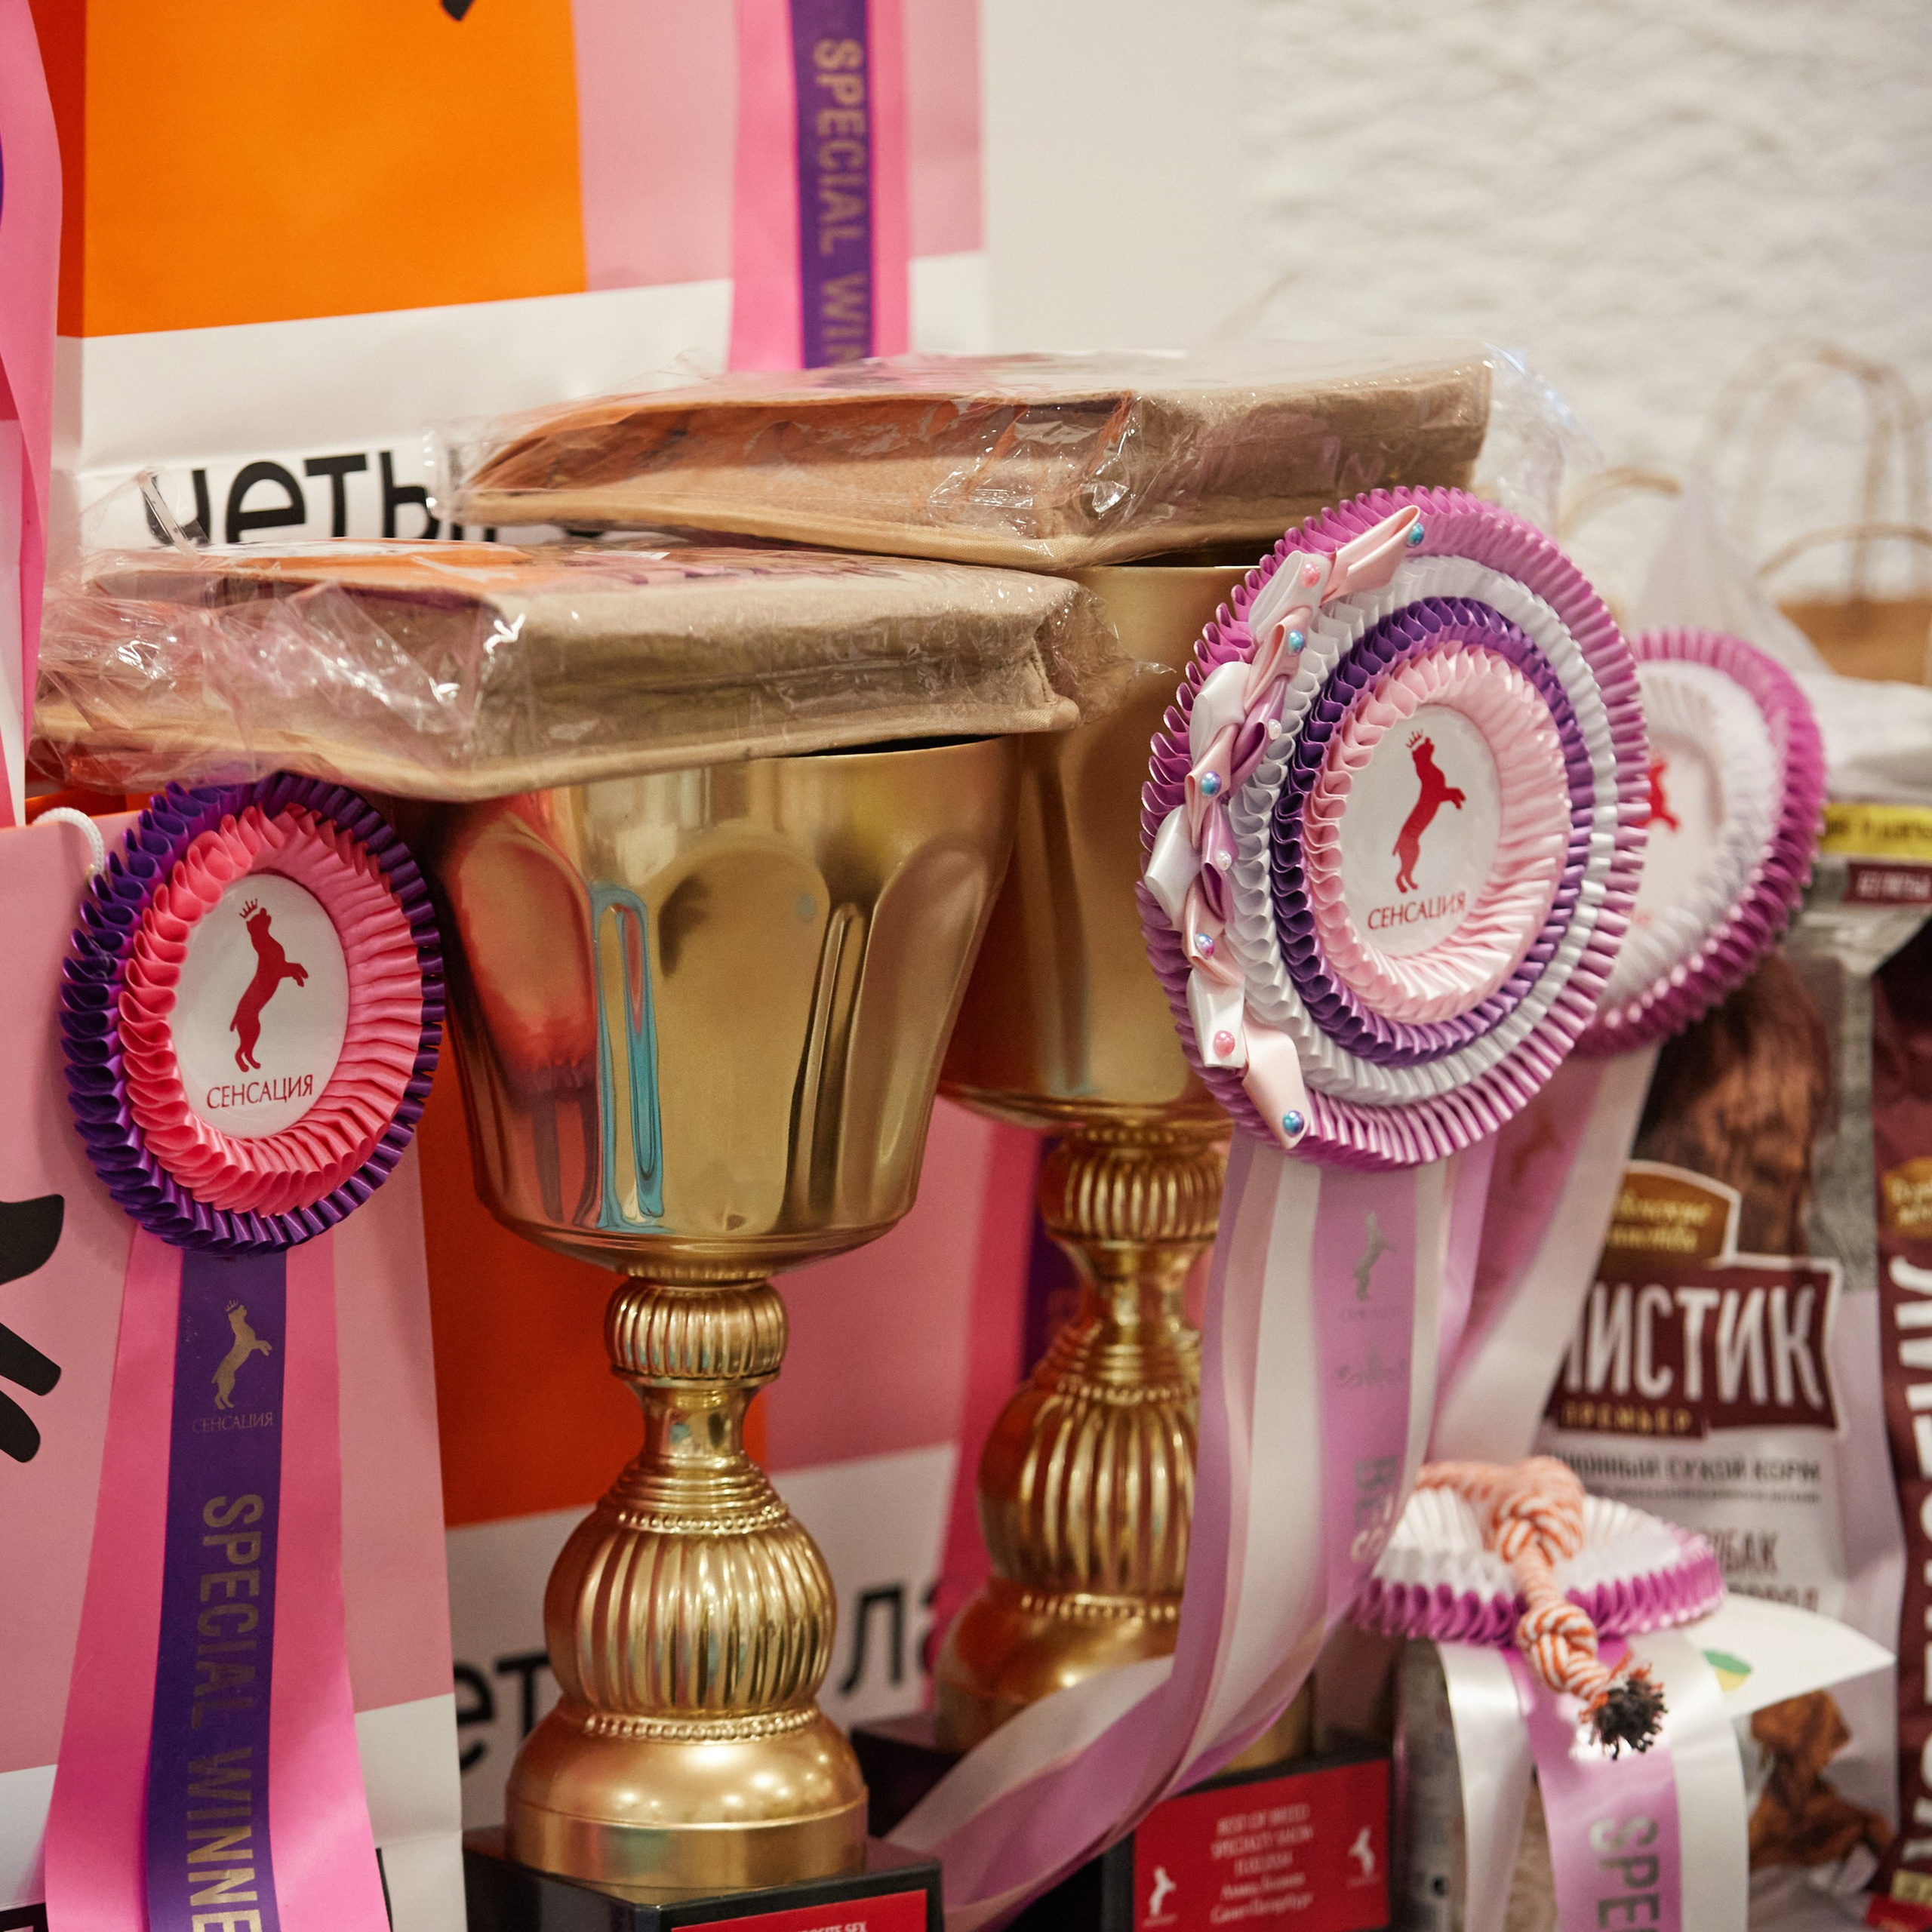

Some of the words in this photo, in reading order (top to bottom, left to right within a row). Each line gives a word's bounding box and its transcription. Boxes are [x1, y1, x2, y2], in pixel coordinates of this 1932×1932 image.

[812, 38, 866, 256] SPECIAL
[1368, 891, 1466, 930] СЕНСАЦИЯ
[206, 1074, 313, 1109] СЕНСАЦИЯ
[192, 1411, 273, 1433] СЕНСАЦИЯ
[1350, 1456, 1398, 1564] BES
[190, 1494, 264, 1729] SPECIAL
[1590, 1817, 1660, 1932] SPE
